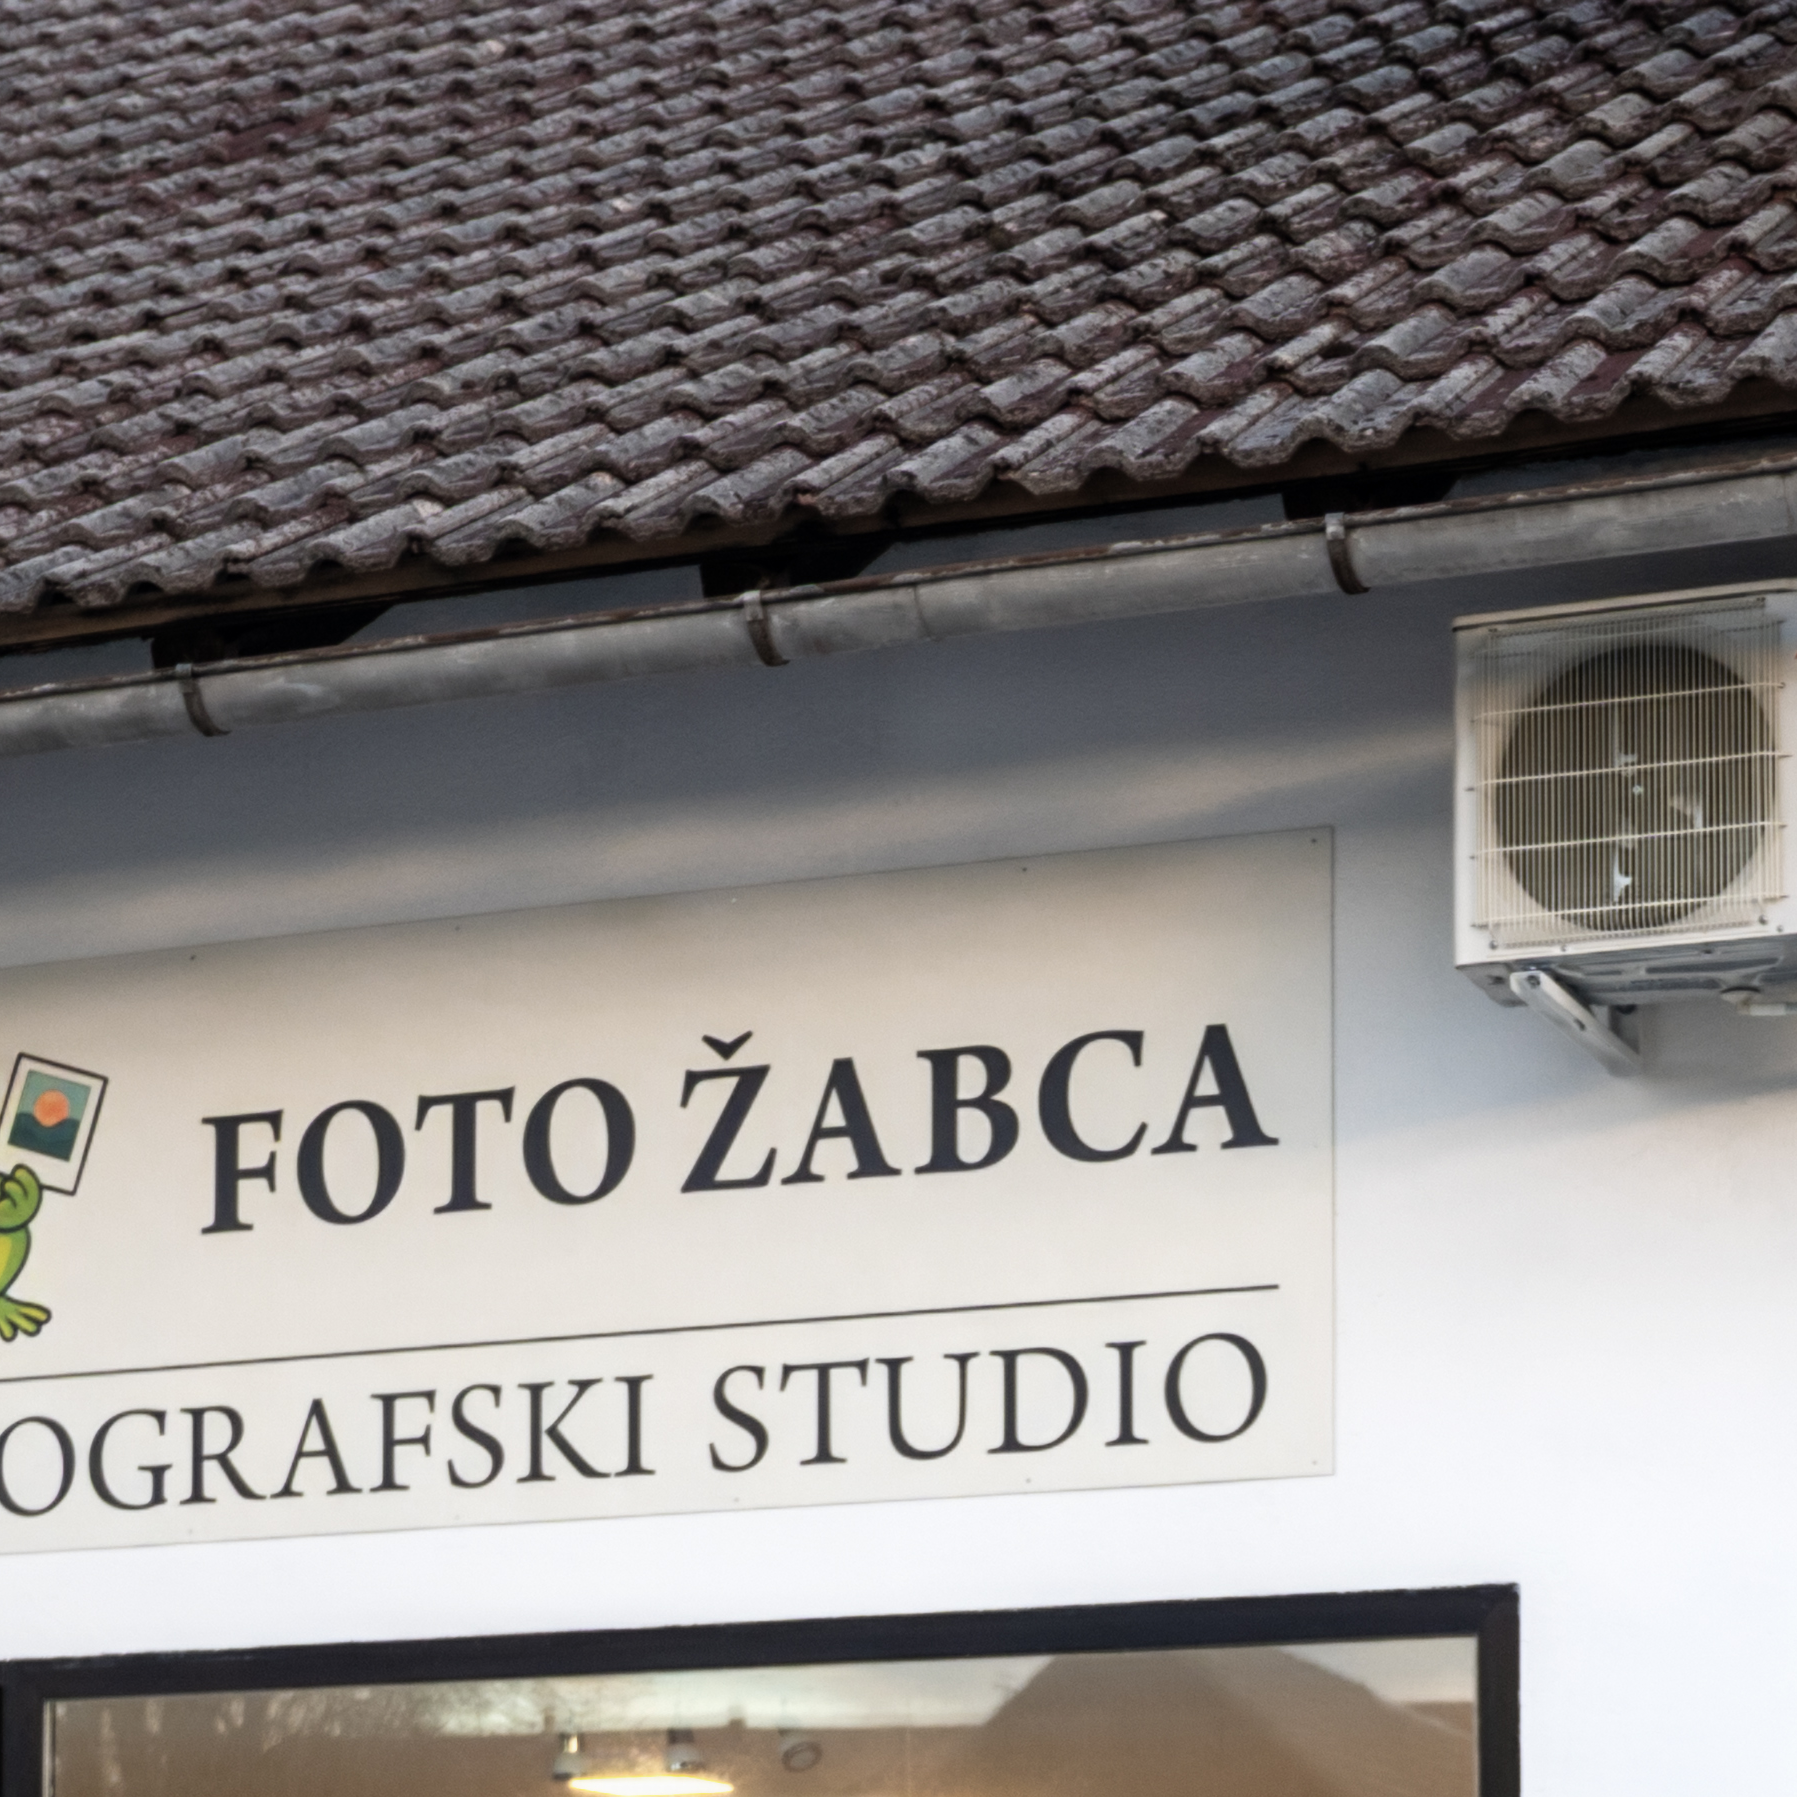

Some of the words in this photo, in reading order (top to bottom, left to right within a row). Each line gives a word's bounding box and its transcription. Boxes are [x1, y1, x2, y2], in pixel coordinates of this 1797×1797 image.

[201, 1077, 636, 1234] FOTO
[680, 1023, 1279, 1194] ŽABCA
[710, 1332, 1267, 1472] STUDIO
